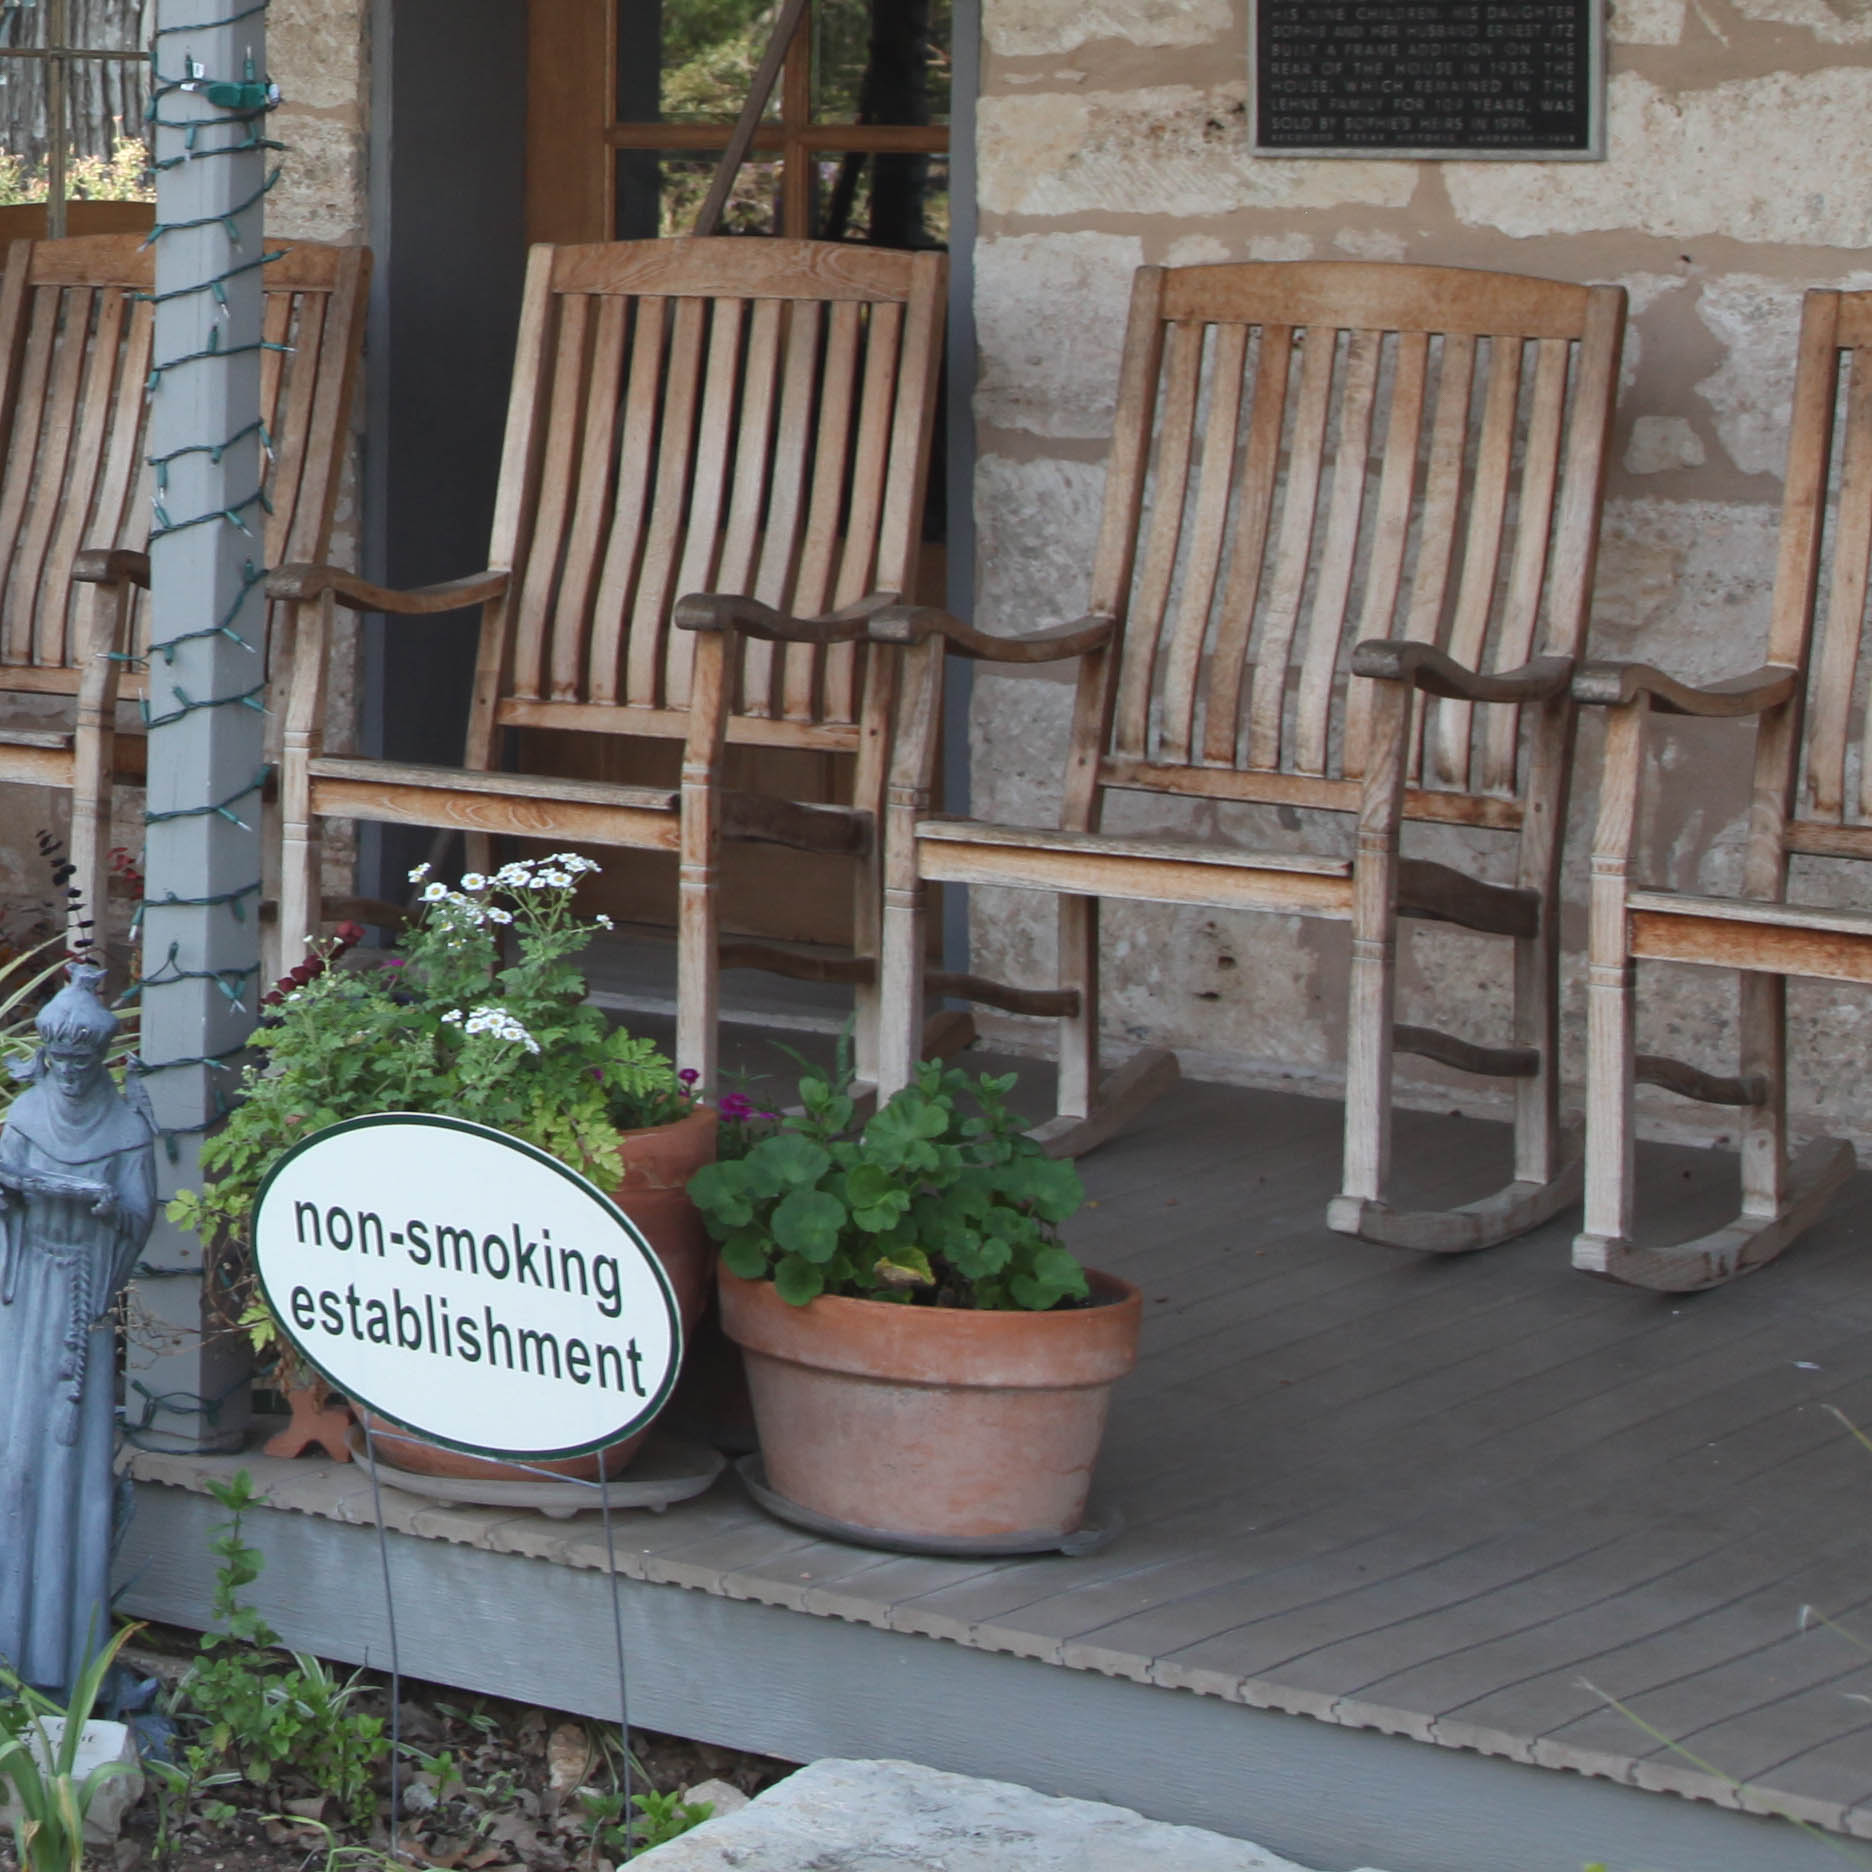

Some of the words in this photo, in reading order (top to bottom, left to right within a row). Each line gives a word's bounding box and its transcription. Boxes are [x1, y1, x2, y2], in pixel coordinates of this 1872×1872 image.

[1543, 41, 1576, 56] THE
[1272, 61, 1312, 75] REAR
[1321, 61, 1343, 76] OF
[1352, 61, 1384, 75] THE
[1395, 61, 1453, 76] HOUSE
[1543, 60, 1576, 75] THE
[1543, 79, 1576, 94] THE
[1392, 97, 1425, 112] FOR
[1540, 98, 1576, 113] WAS
[1272, 116, 1312, 131] SOLD
[1319, 116, 1337, 131] BY
[294, 1199, 622, 1318] non-smoking
[290, 1283, 647, 1398] establishment
